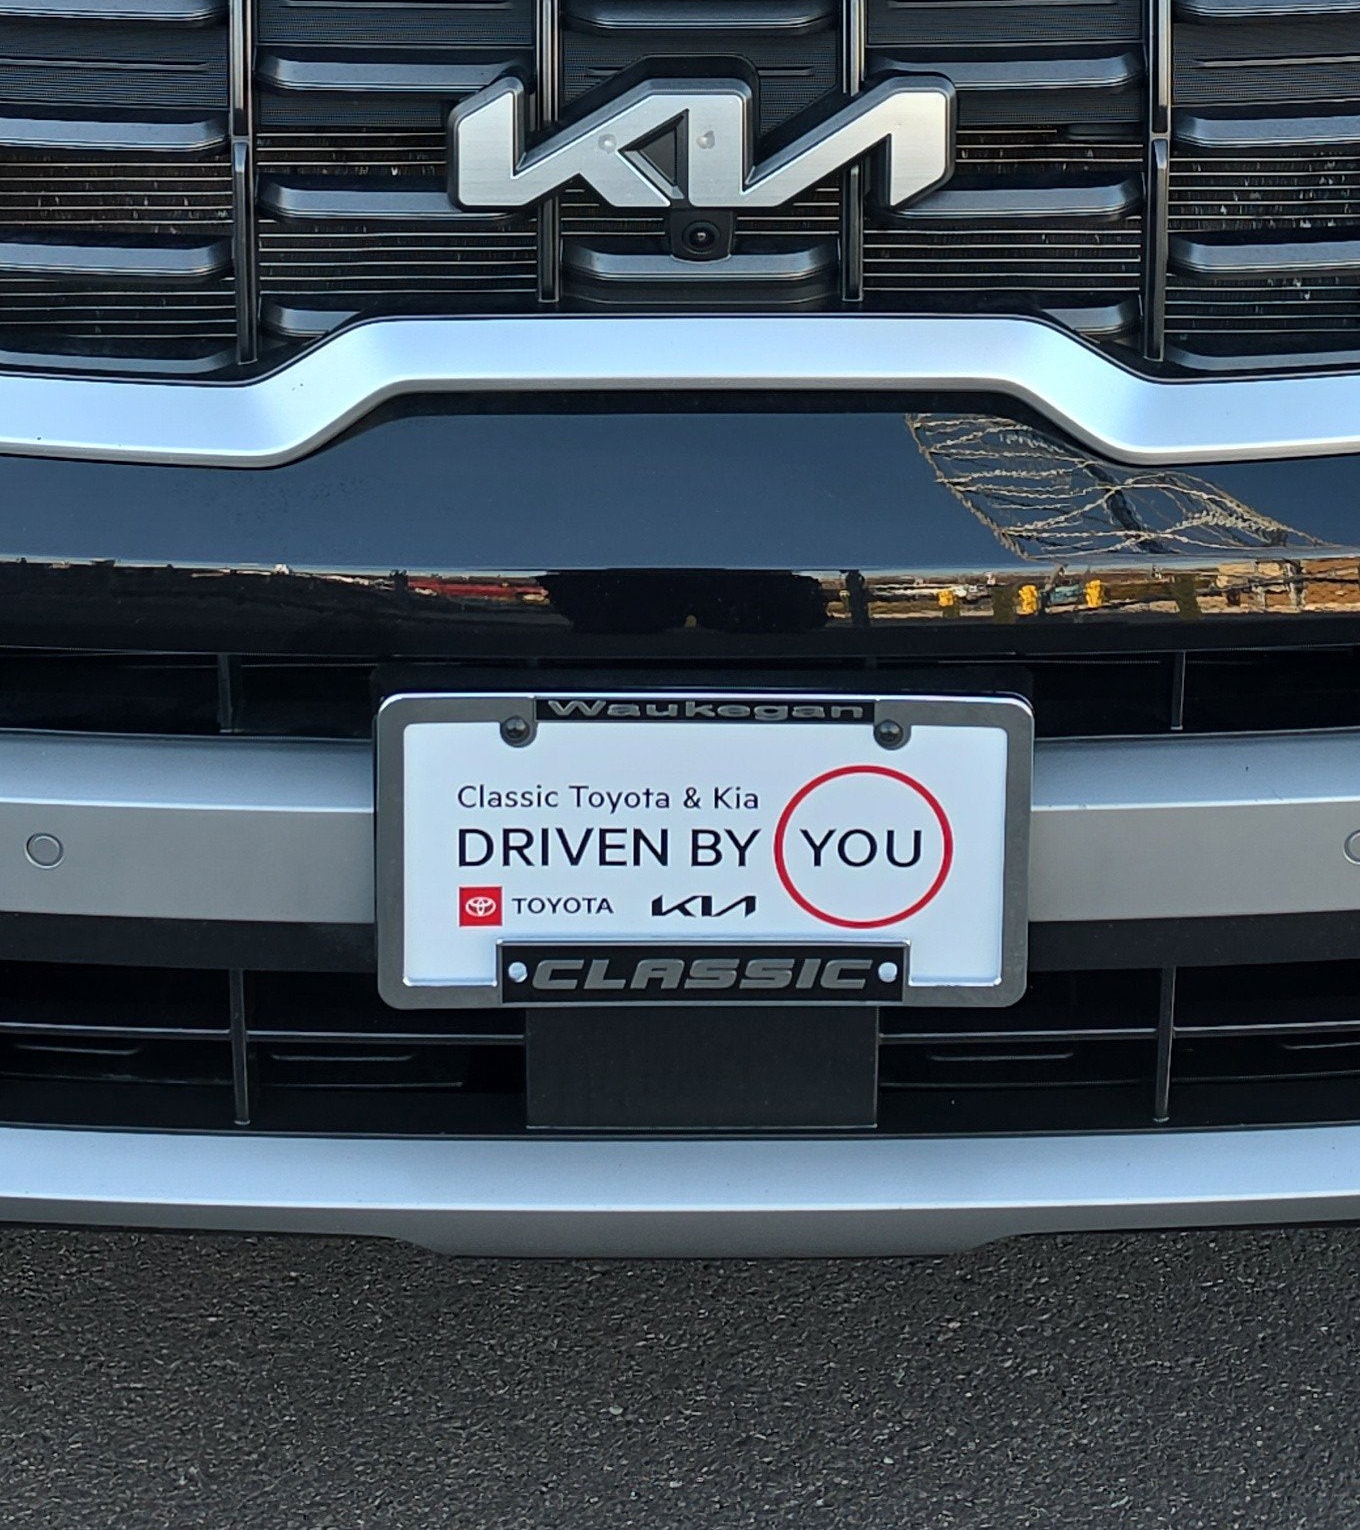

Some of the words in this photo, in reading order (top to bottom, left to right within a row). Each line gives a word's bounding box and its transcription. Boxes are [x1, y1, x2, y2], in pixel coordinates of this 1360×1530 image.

[448, 76, 954, 210] KIA
[546, 699, 863, 720] Waukegan
[457, 785, 559, 809] Classic
[569, 785, 671, 814] Toyota
[682, 786, 702, 810] &
[713, 786, 759, 810] Kia
[458, 828, 668, 867] DRIVEN
[691, 828, 761, 867] BY
[800, 828, 923, 868] YOU
[512, 897, 613, 915] TOYOTA
[532, 959, 873, 990] CLASSIC
